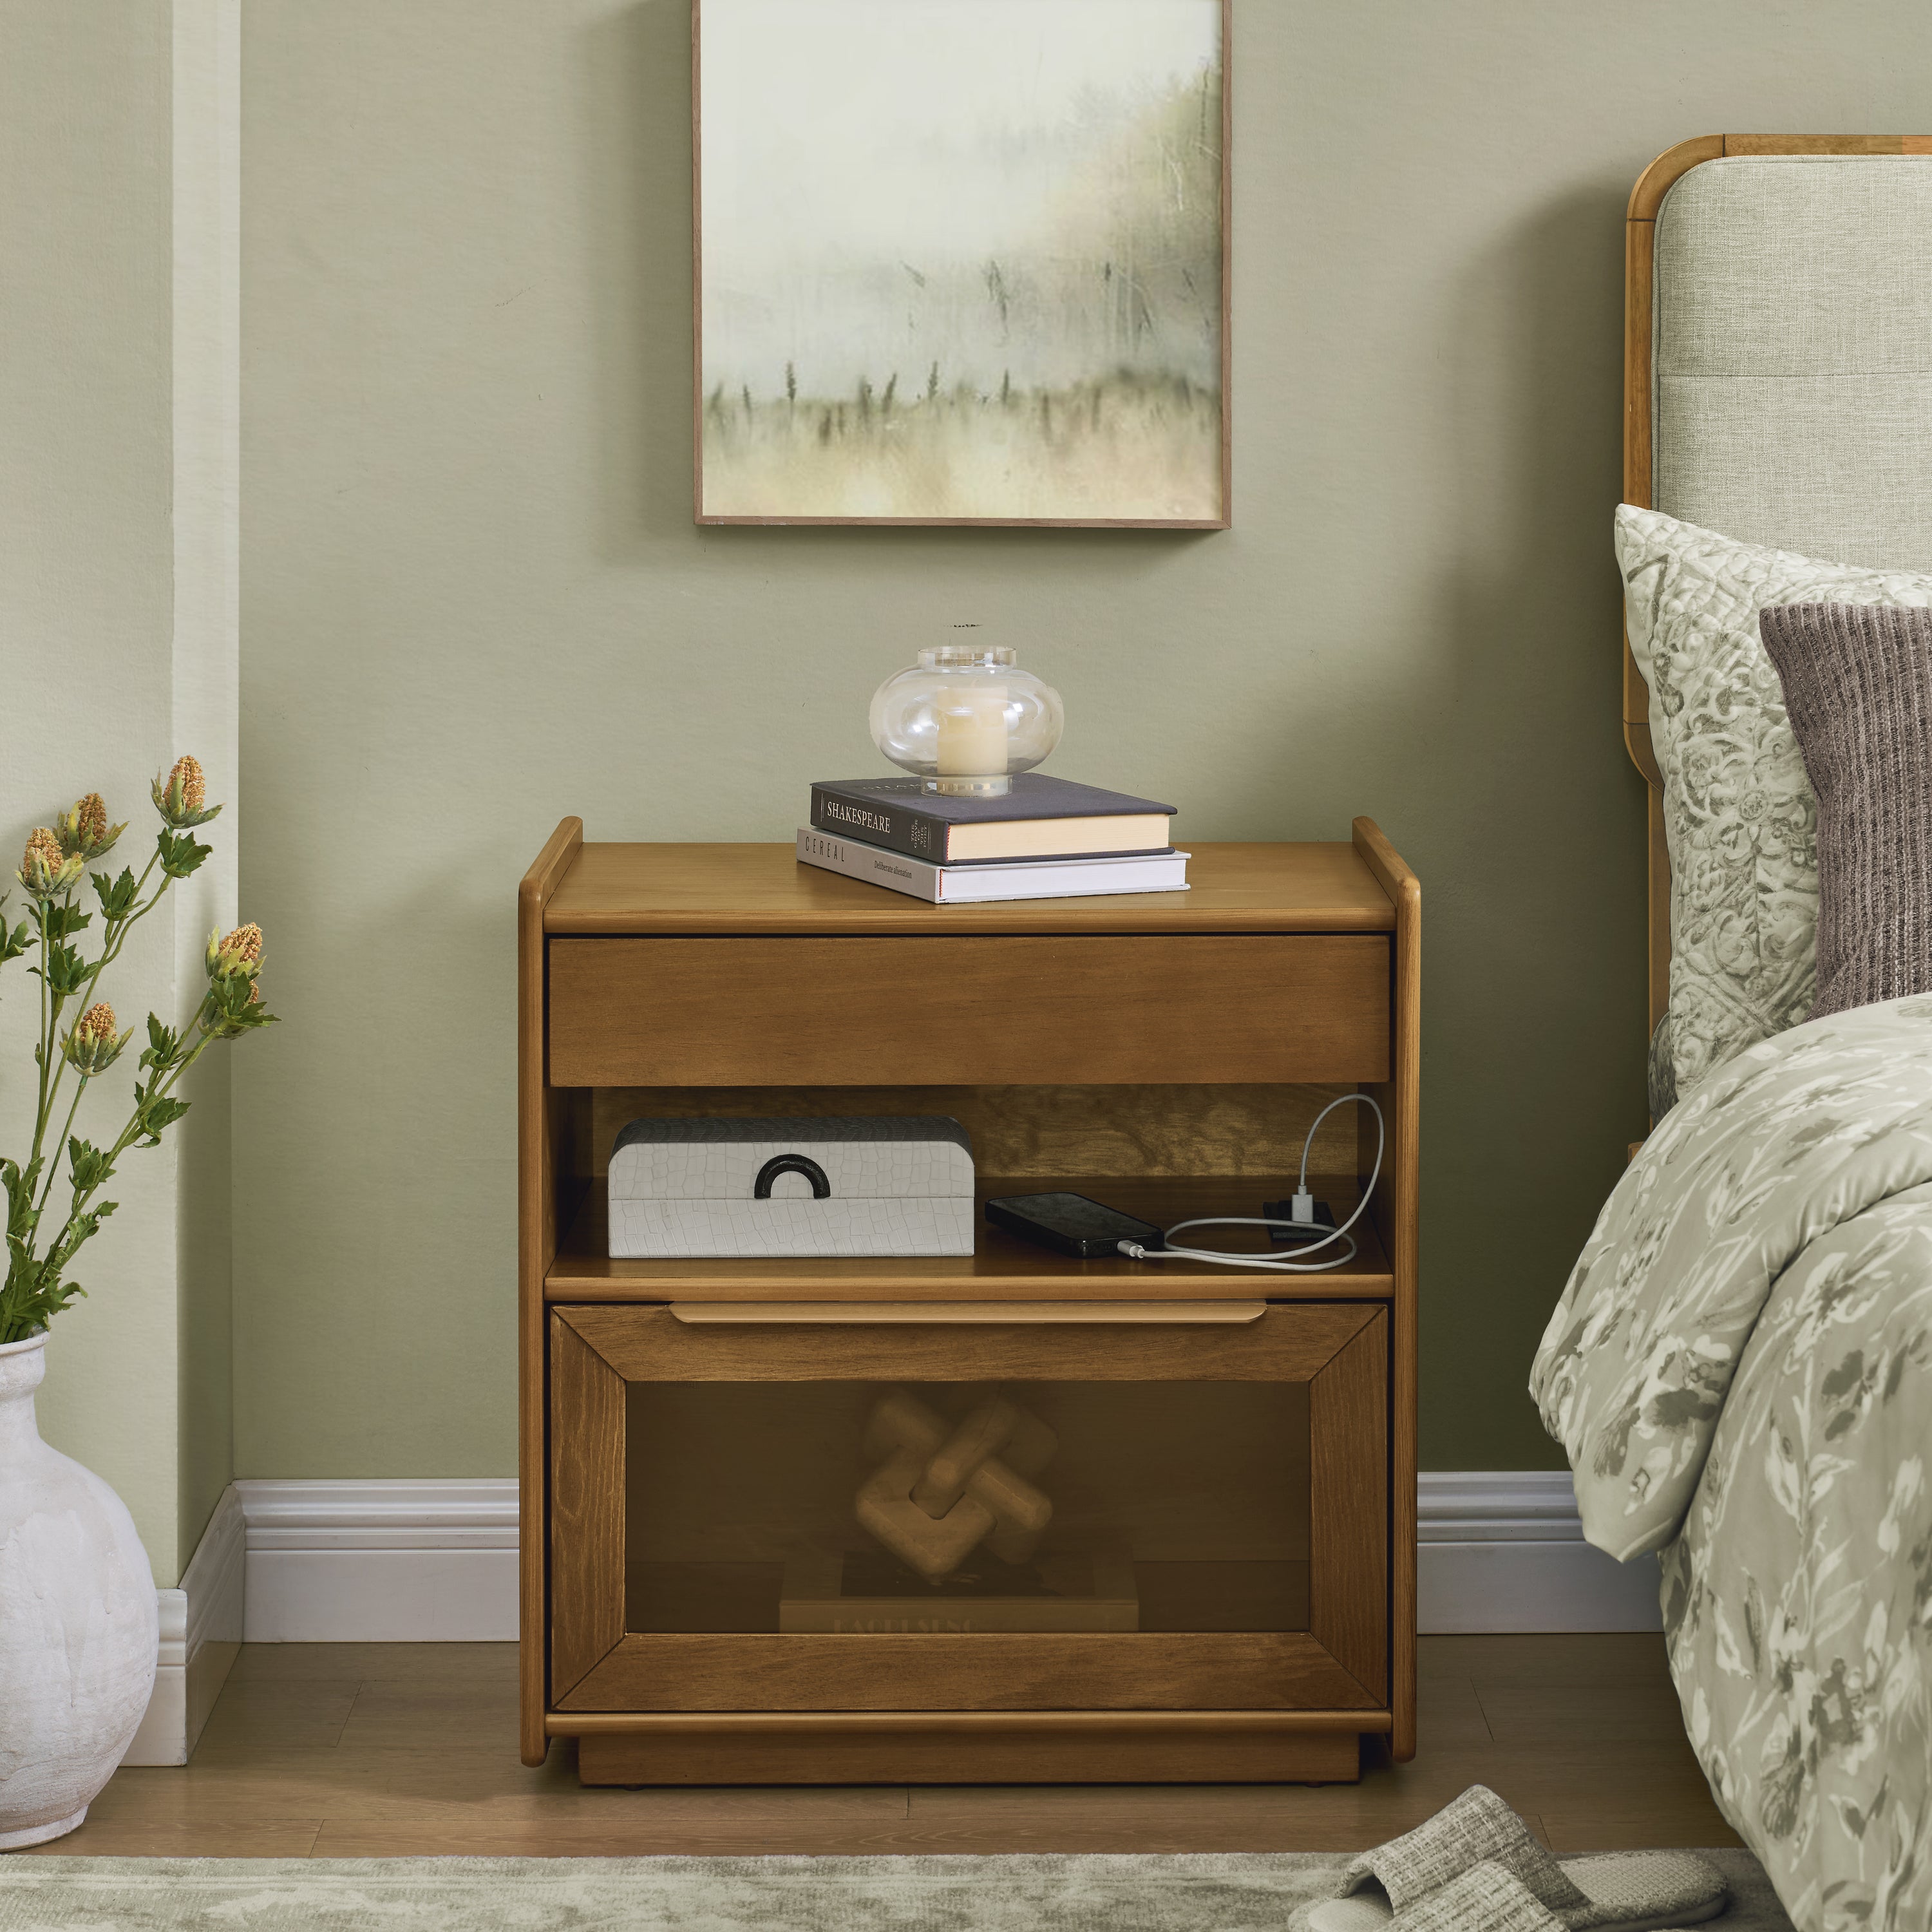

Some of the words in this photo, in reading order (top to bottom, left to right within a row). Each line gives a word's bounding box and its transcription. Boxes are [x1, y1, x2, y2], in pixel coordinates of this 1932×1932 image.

[827, 801, 891, 833] SHAKESPEARE
[806, 836, 845, 862] CEREAL
[874, 860, 893, 873] Deliberate
[893, 866, 912, 879] alienation
